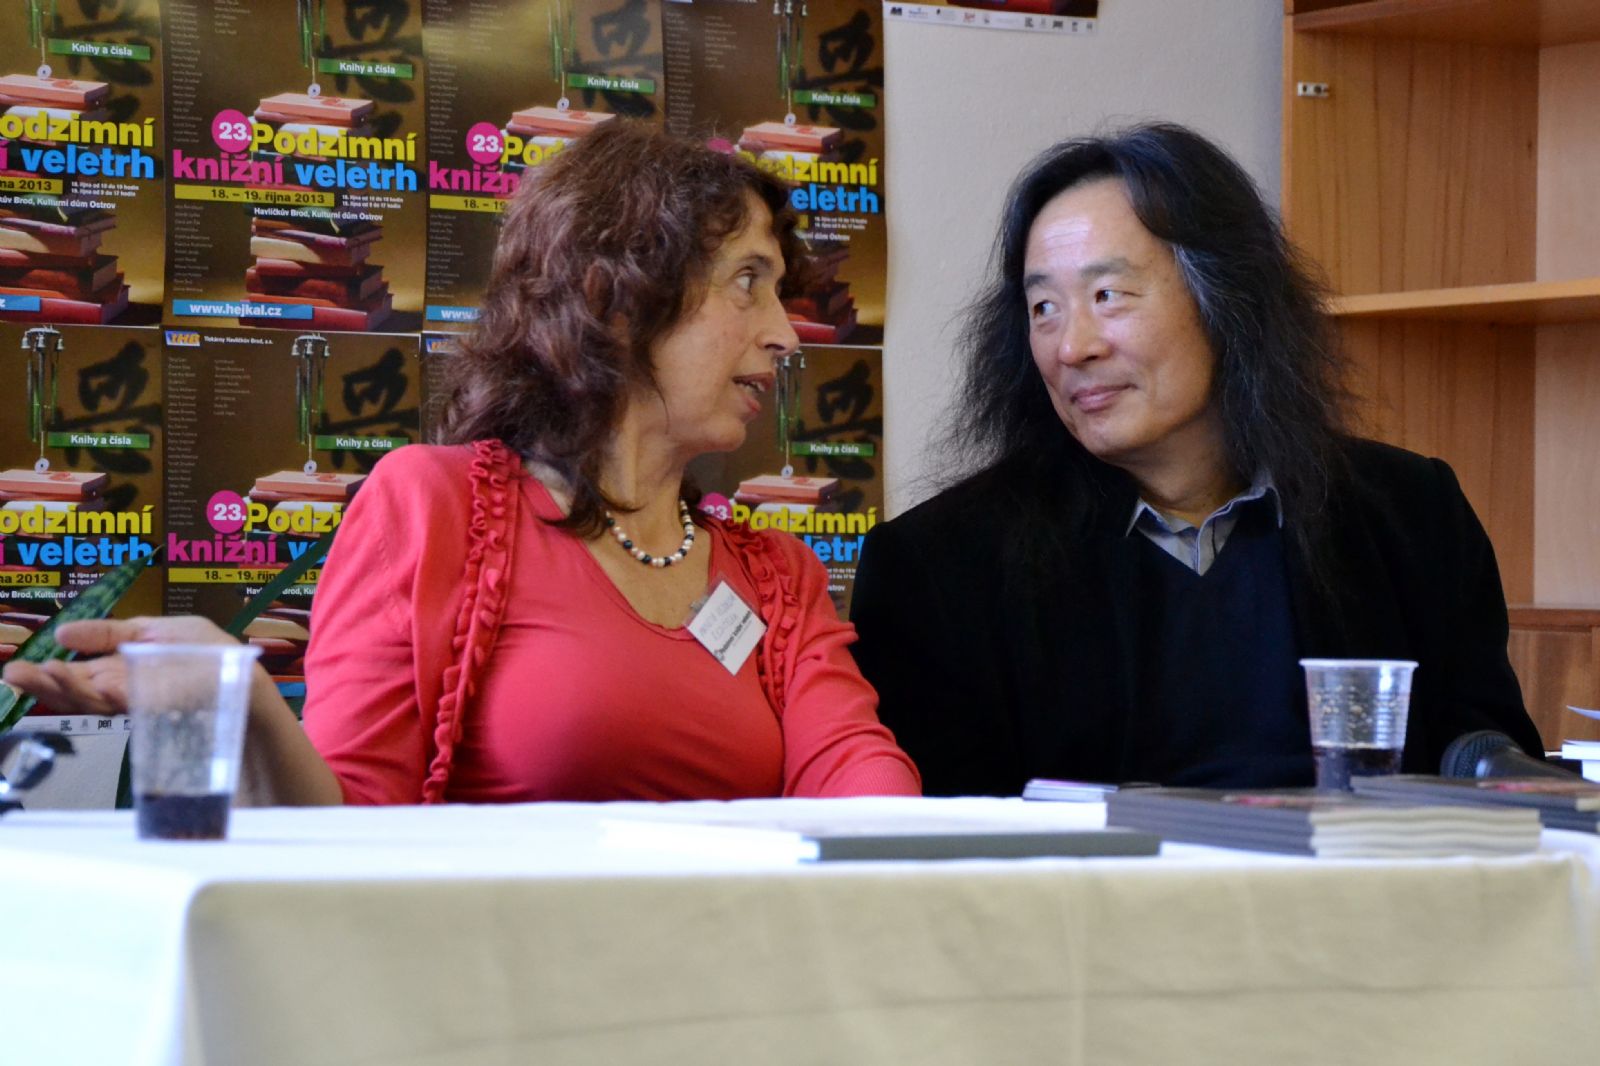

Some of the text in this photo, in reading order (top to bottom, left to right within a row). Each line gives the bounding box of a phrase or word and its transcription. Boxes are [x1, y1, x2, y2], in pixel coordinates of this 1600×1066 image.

[71, 43, 100, 55] Knihy
[339, 62, 365, 74] Knihy
[587, 77, 610, 89] Knihy
[613, 80, 618, 88] a
[0, 111, 155, 147] odzimní
[219, 122, 417, 161] 23. Podzimní
[472, 134, 503, 153] 23.
[20, 144, 155, 178] veletrh
[173, 149, 417, 191] knižní veletrh
[429, 160, 523, 193] knižn
[19, 180, 52, 191] 2013
[14, 196, 35, 206] Brod,
[90, 200, 116, 209] Ostrov
[211, 189, 229, 199] 18.
[244, 190, 261, 201] 19.
[265, 191, 291, 204] října
[294, 193, 325, 204] 2013
[463, 199, 479, 209] 18.
[790, 183, 878, 213] eletrh
[359, 212, 383, 221] Ostrov
[189, 303, 282, 318] www.hejkal.cz
[70, 434, 98, 446] Knihy
[336, 438, 361, 449] Knihy
[0, 504, 154, 534] odzimní
[213, 503, 343, 533] 23. Podzi
[17, 536, 154, 566] veletrh
[167, 532, 277, 564] knižní
[16, 573, 49, 584] 2013
[204, 571, 222, 581] 18.
[238, 571, 254, 581] 19.
[257, 571, 276, 585] říjn
[12, 591, 33, 599] Brod,
